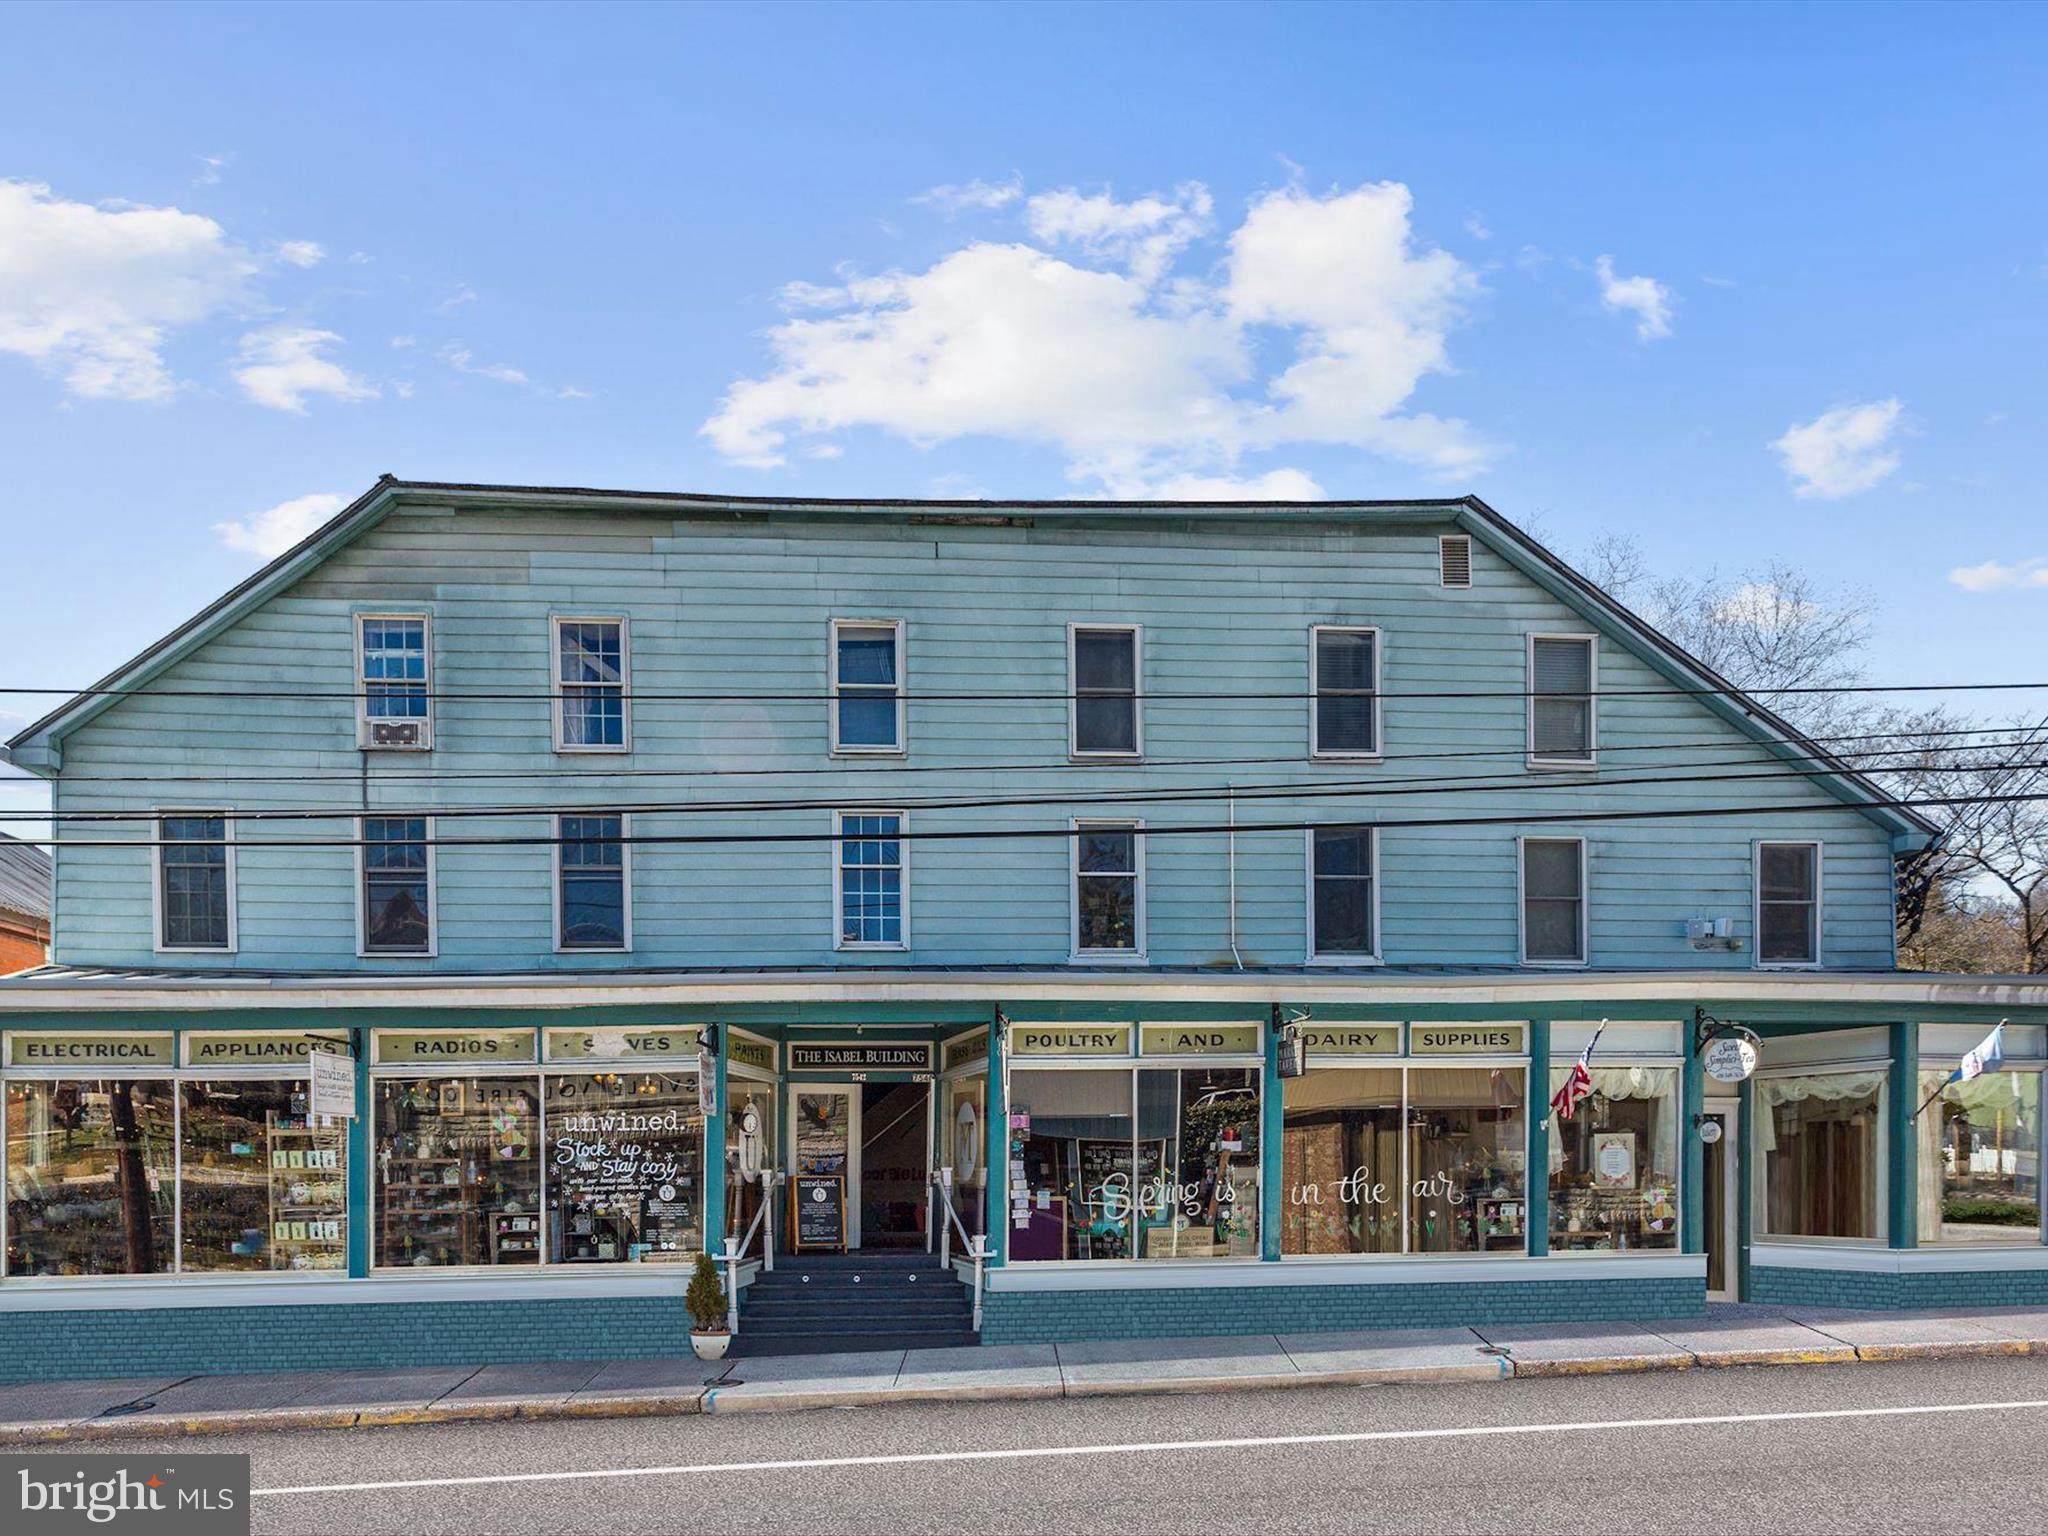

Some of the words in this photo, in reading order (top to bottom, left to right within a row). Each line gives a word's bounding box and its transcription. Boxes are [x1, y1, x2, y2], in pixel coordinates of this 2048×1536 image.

[414, 1040, 498, 1054] RADIOS
[583, 1037, 670, 1051] SVES
[1025, 1034, 1118, 1048] POULTRY
[1177, 1034, 1225, 1047] AND
[1305, 1034, 1378, 1046] DAIRY
[1423, 1033, 1510, 1047] SUPPLIES
[26, 1043, 156, 1057] ELECTRICAL
[796, 1050, 821, 1063] THE
[825, 1051, 864, 1063] ISABEL
[866, 1050, 925, 1063] BUILDING
[563, 1110, 686, 1132] unwined.
[556, 1137, 611, 1164] Stock
[620, 1142, 641, 1161] up
[576, 1160, 599, 1171] AND
[640, 1162, 678, 1181] cozy
[1101, 1172, 1201, 1219] Spring
[1215, 1180, 1236, 1203] is
[1290, 1181, 1325, 1206] in
[1328, 1165, 1392, 1205] the
[1412, 1170, 1465, 1205] air
